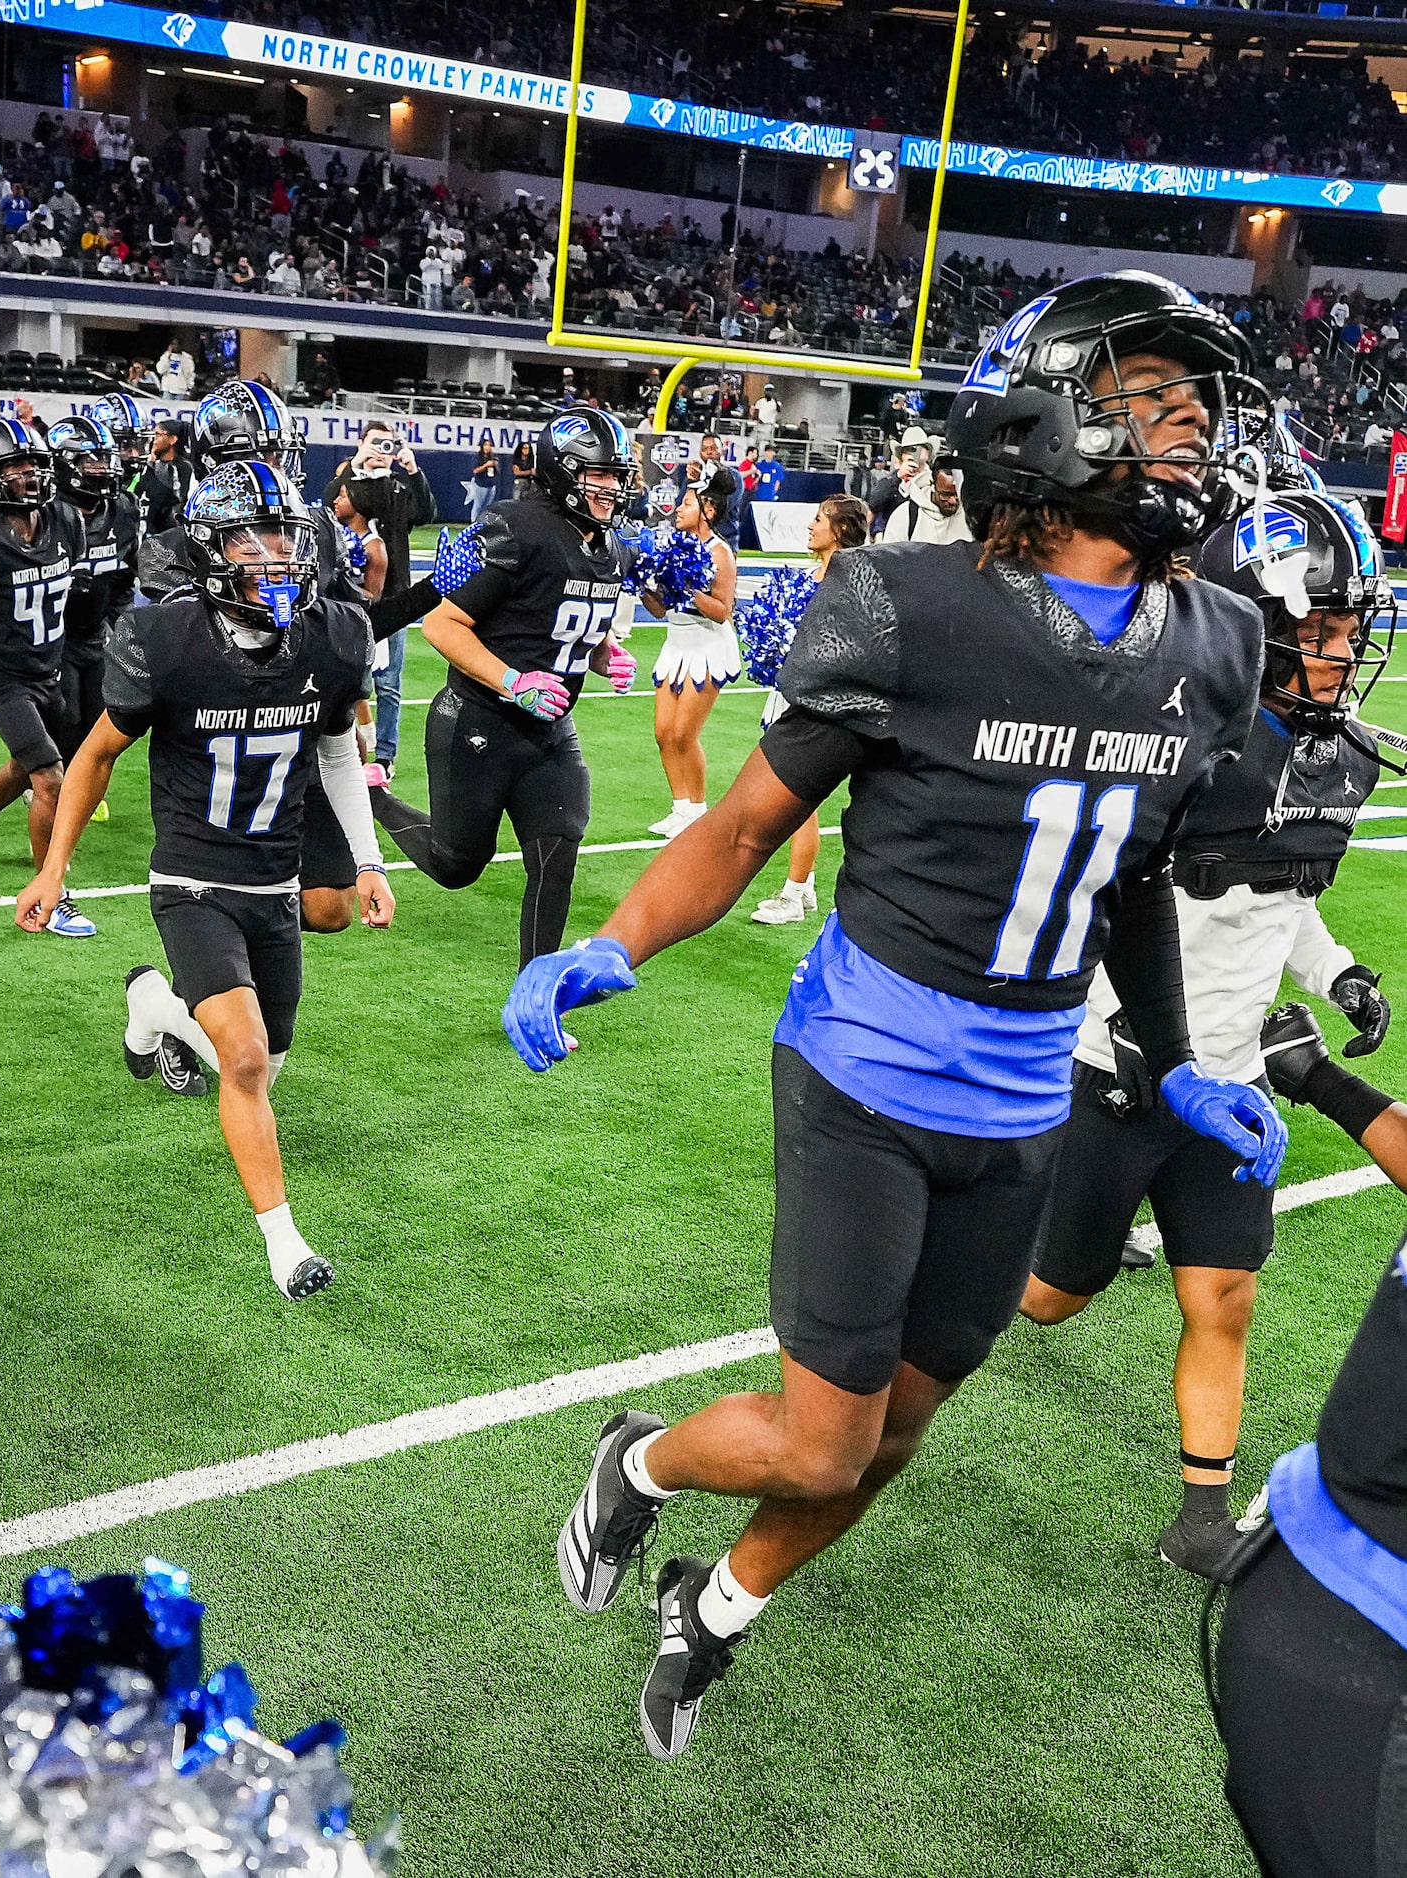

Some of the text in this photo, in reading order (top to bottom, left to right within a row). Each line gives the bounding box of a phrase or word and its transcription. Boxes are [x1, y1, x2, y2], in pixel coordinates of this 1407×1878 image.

[262, 34, 347, 71] NORTH
[357, 50, 472, 91] CROWLEY
[12, 567, 40, 585] NORTH
[563, 579, 622, 598] NORTH CROWLEY
[13, 575, 73, 646] 43
[551, 600, 617, 675] 95
[194, 701, 321, 730] NORTH CROWLEY
[973, 719, 1189, 776] NORTH CROWLEY
[207, 728, 302, 834] 17
[984, 778, 1140, 980] 11
